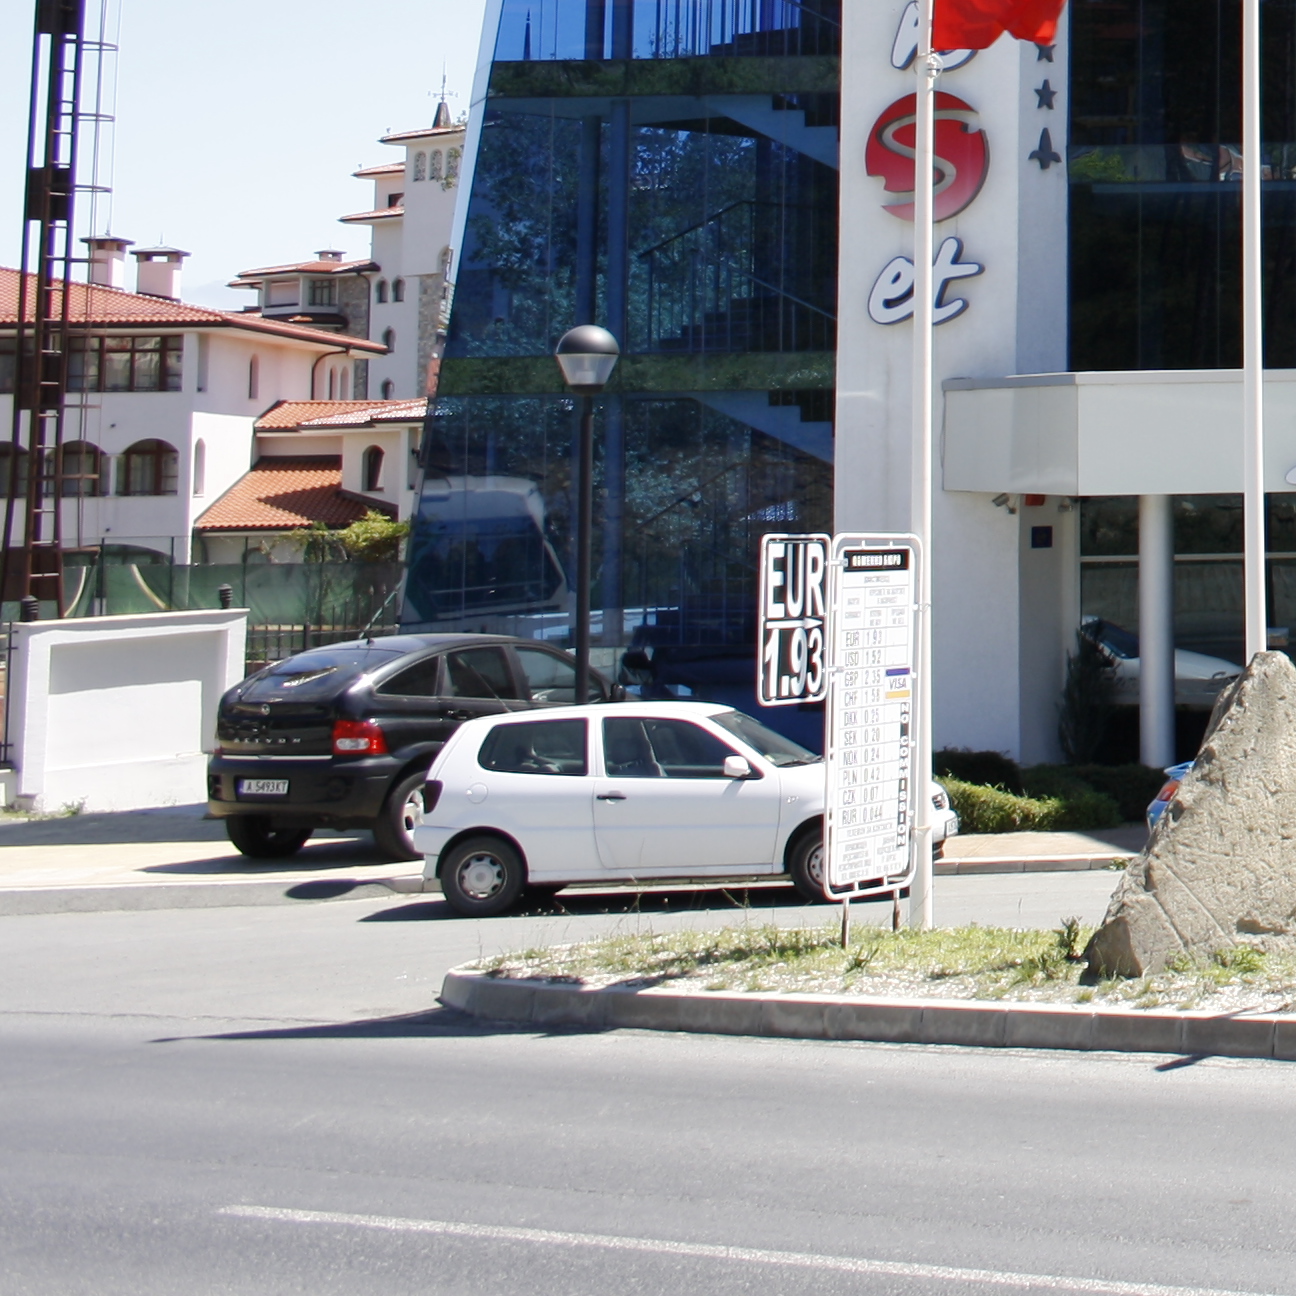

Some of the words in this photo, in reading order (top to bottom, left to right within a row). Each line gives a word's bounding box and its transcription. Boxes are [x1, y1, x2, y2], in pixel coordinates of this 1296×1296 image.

[768, 542, 825, 620] EUR
[845, 631, 860, 647] EUR
[764, 626, 824, 699] 1.93
[889, 676, 908, 691] VISA
[900, 702, 910, 724] NO
